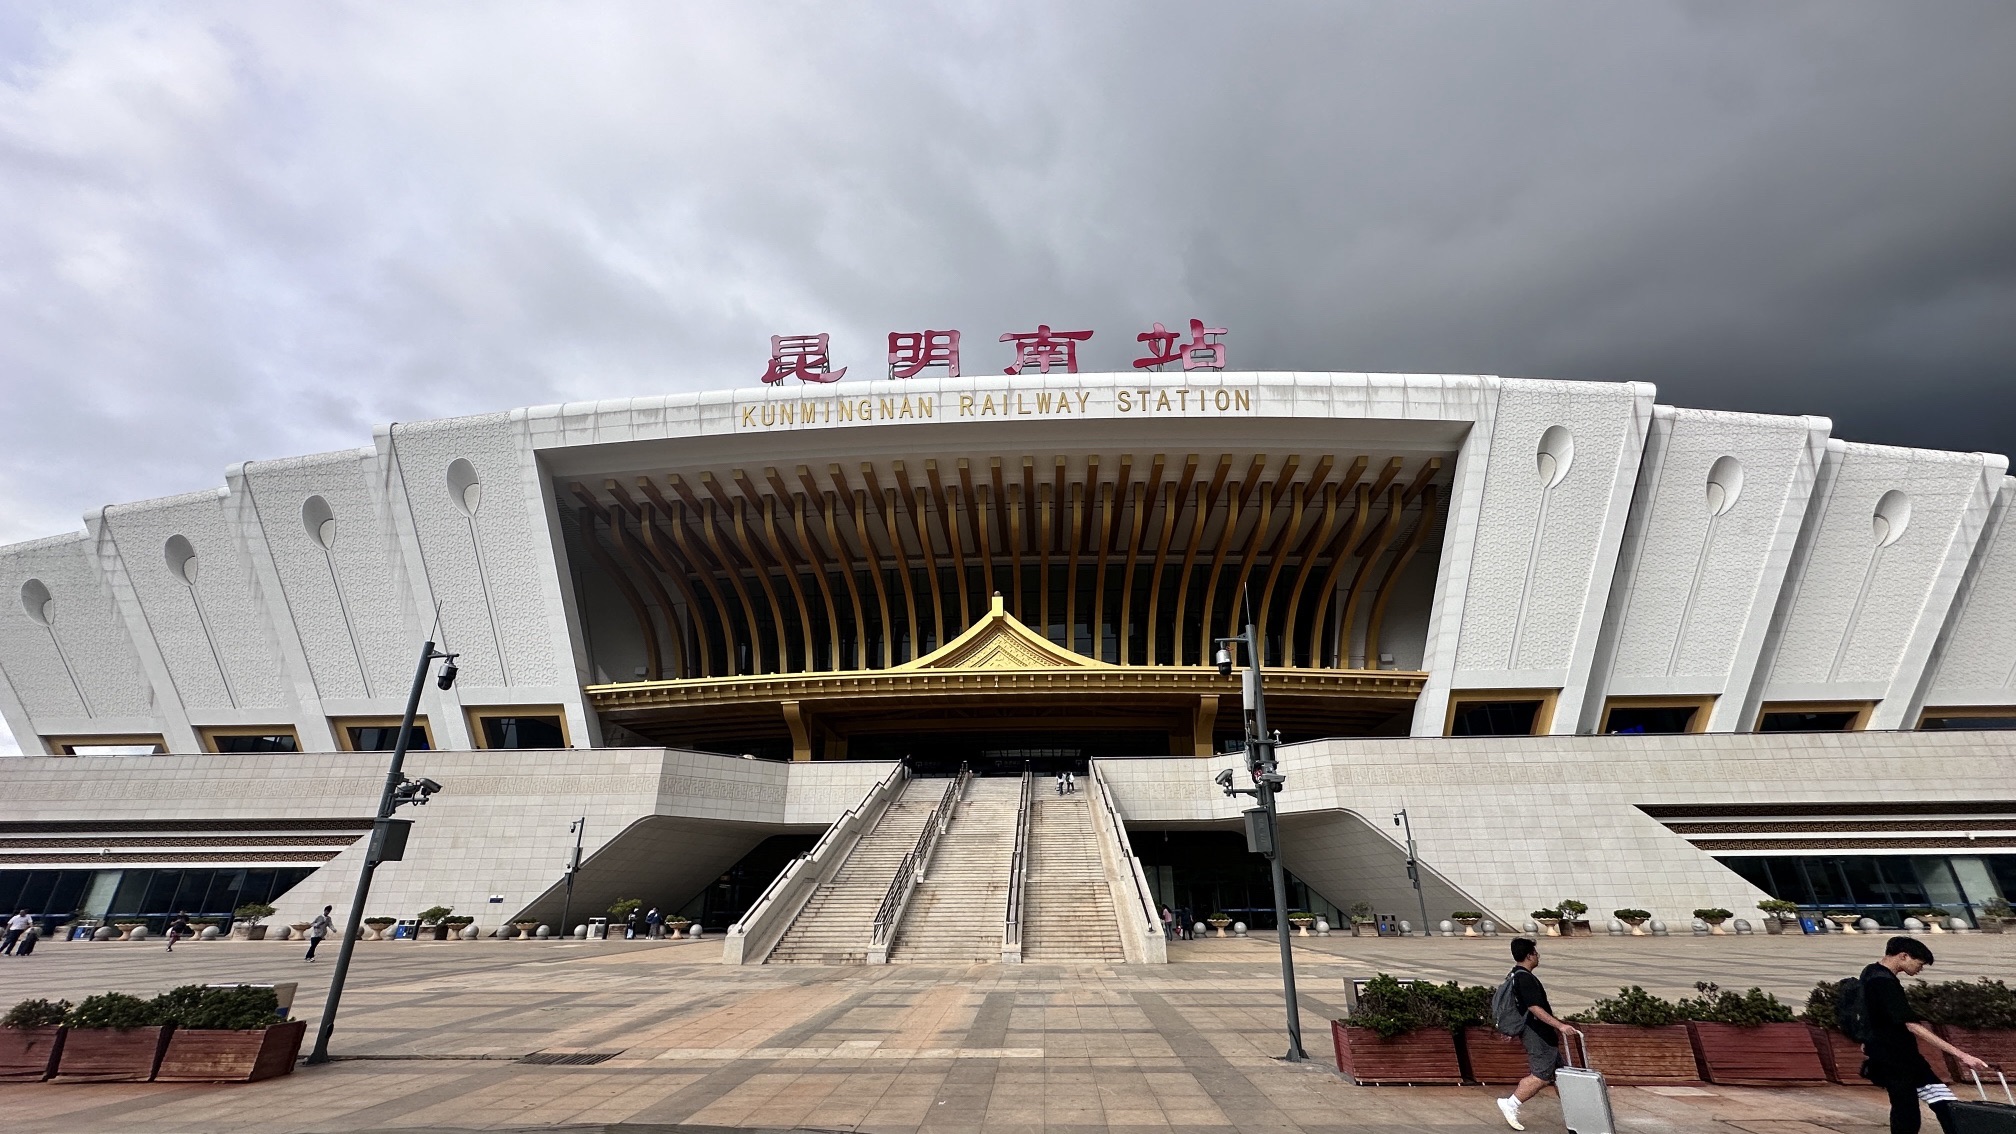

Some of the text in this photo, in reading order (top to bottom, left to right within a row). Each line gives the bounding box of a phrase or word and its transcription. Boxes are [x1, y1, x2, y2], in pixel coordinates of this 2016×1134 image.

[761, 319, 1228, 384] 昆明南站
[742, 389, 1250, 427] KUNMINGNAN RAILWAY STATION
